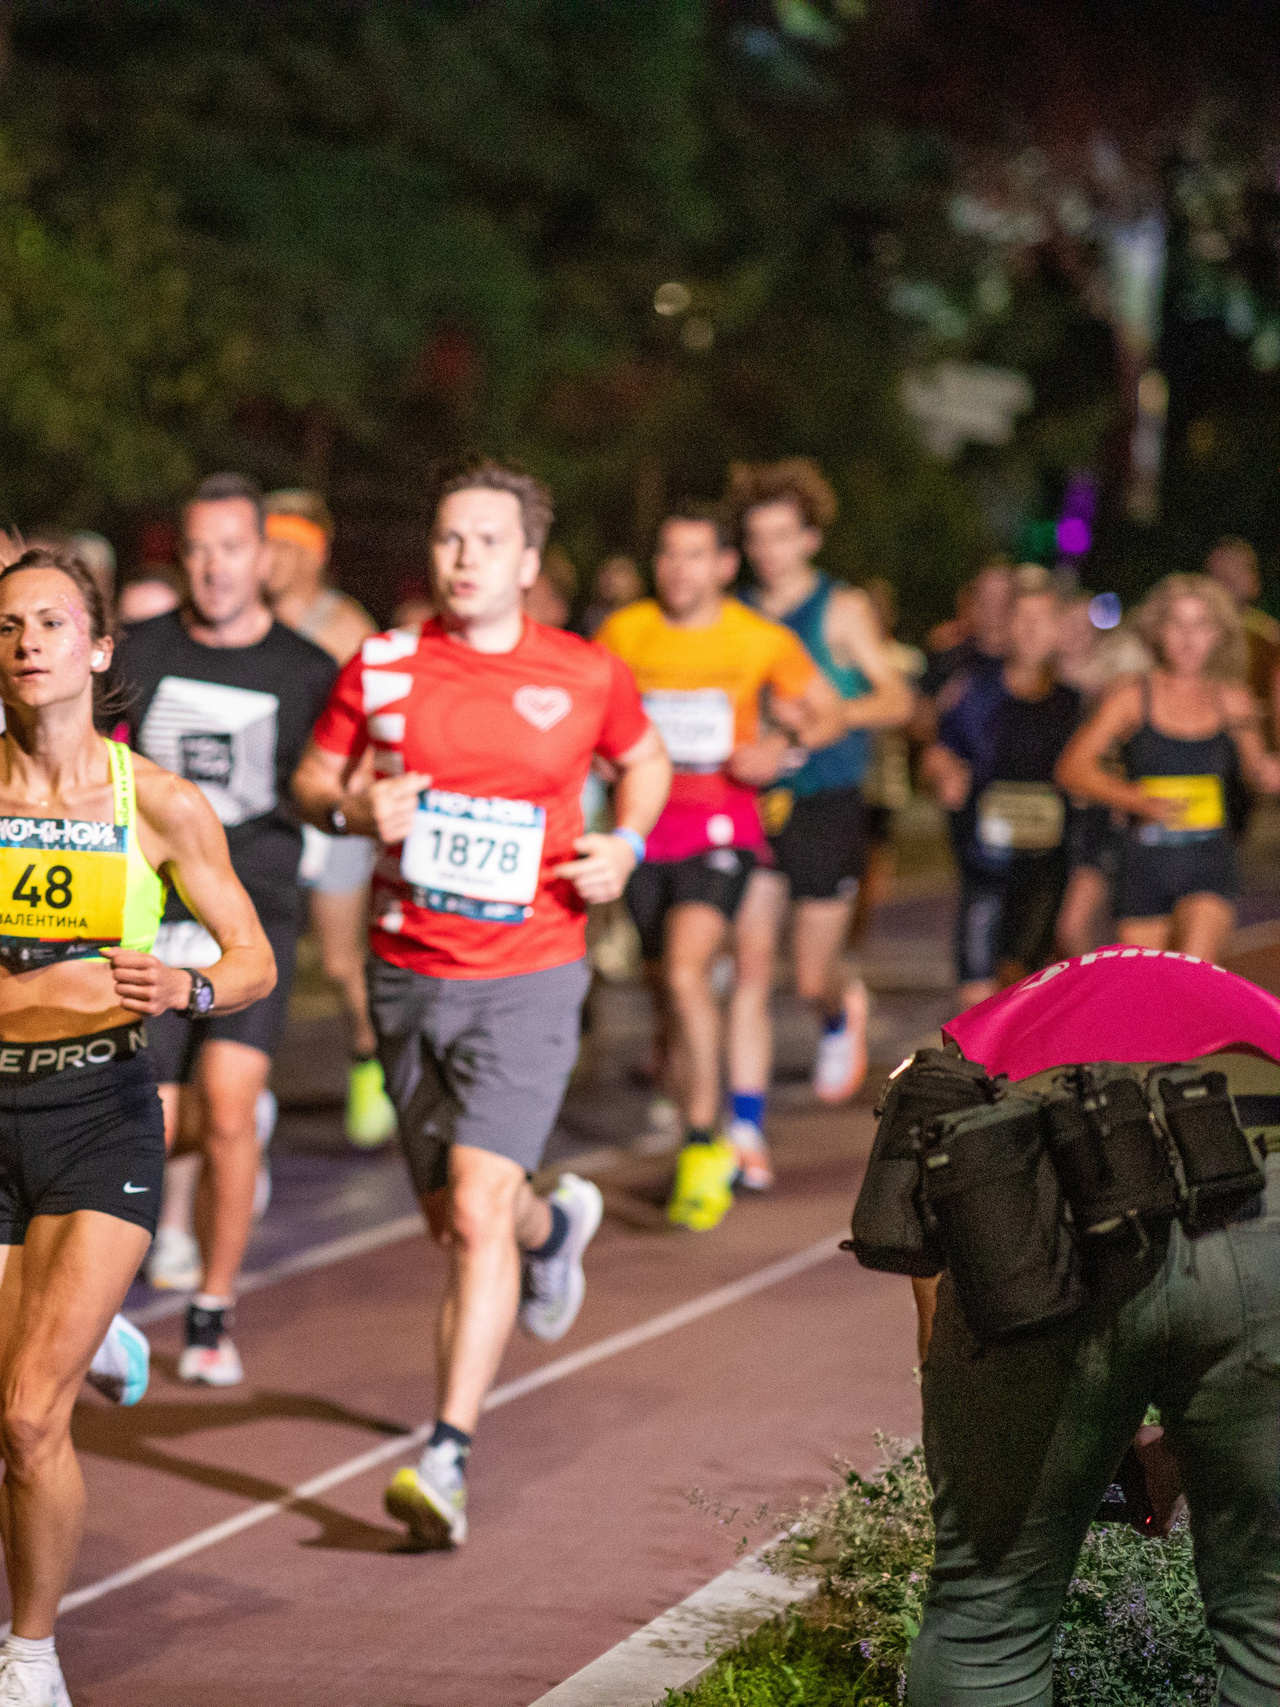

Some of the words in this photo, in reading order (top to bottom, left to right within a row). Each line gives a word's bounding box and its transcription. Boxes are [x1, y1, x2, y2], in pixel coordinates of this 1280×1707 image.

[429, 829, 520, 874] 1878
[12, 864, 73, 910] 48
[27, 1038, 117, 1074] PRO
